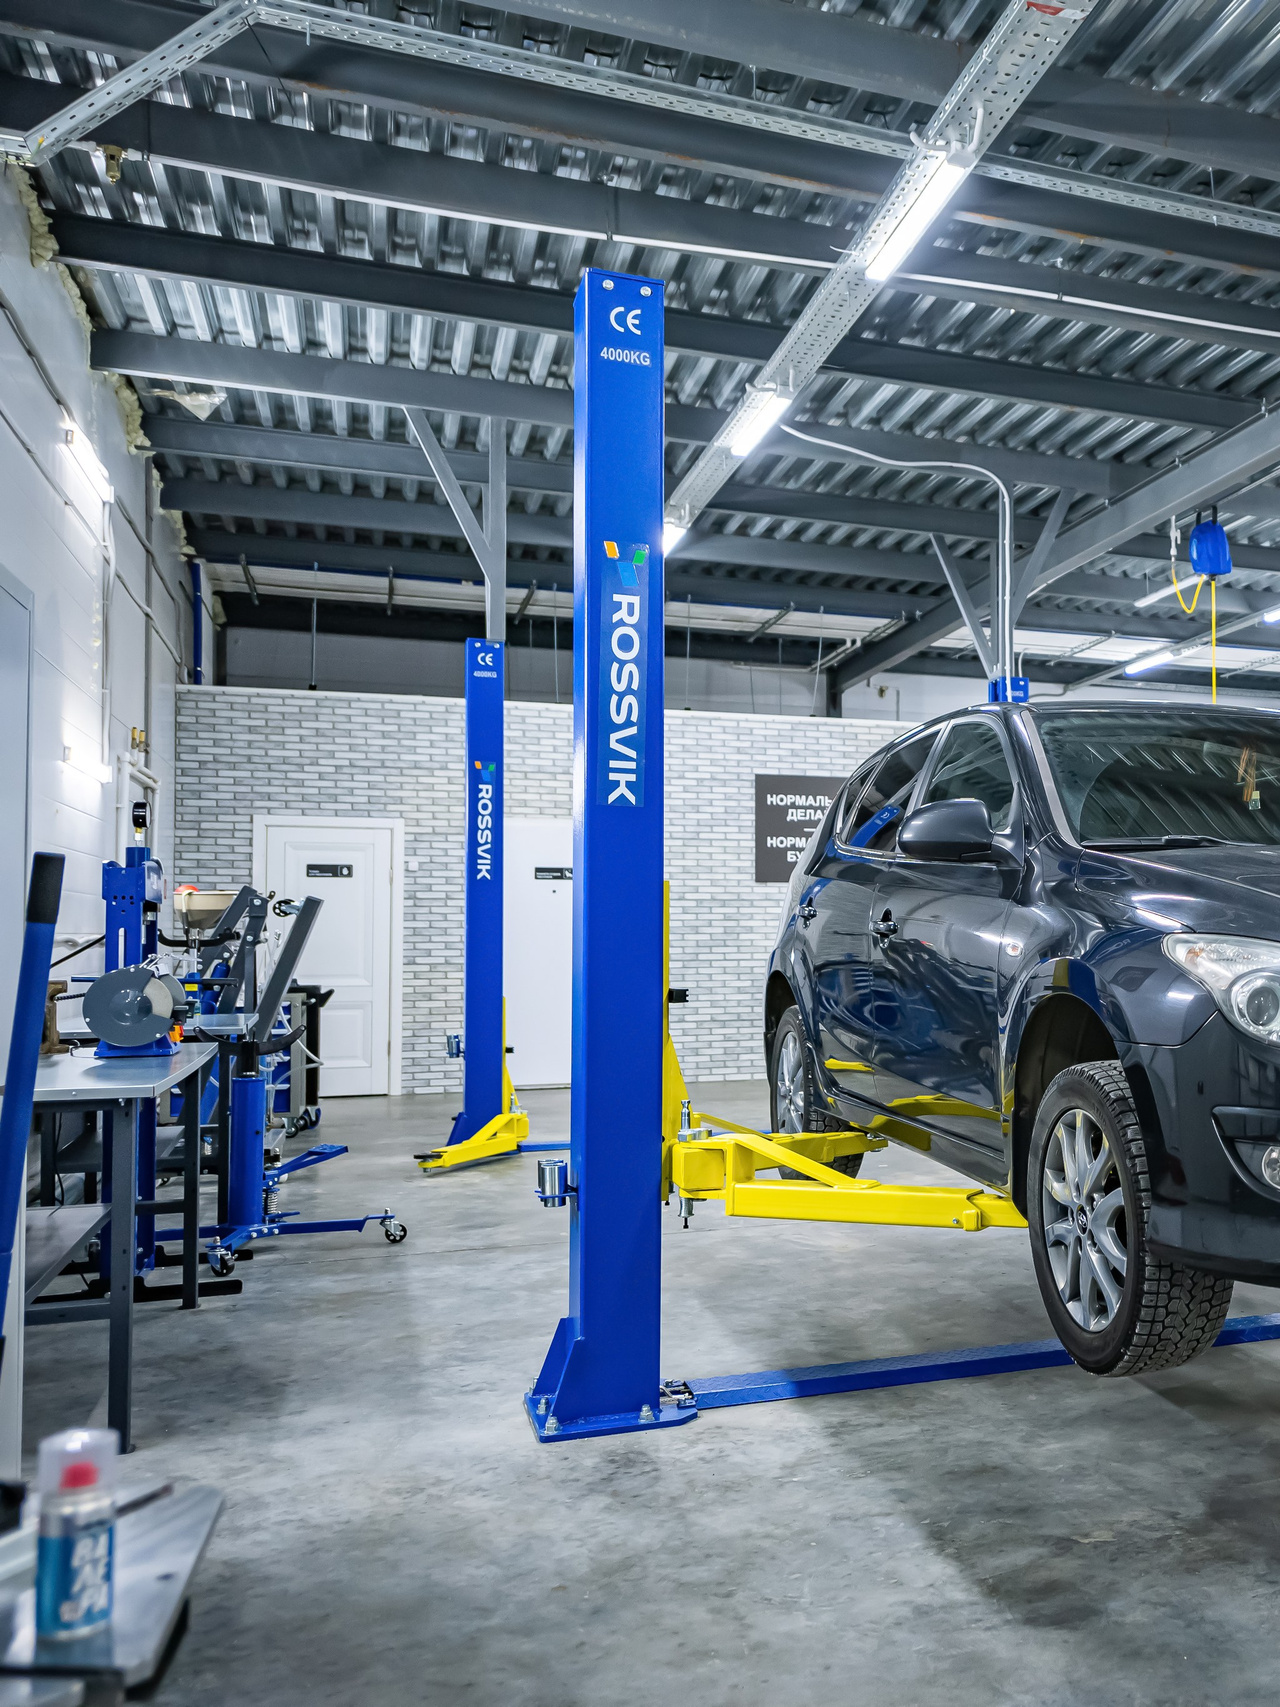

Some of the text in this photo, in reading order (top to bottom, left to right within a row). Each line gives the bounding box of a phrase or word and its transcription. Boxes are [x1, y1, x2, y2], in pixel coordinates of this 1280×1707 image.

[609, 306, 642, 336] CE
[600, 346, 651, 366] 4000KG
[477, 652, 494, 667] CE
[607, 593, 641, 806] ROSSVIK
[766, 793, 834, 807] НОРМАЛЬ
[476, 783, 492, 880] ROSSVIK
[786, 850, 804, 863] БУ
